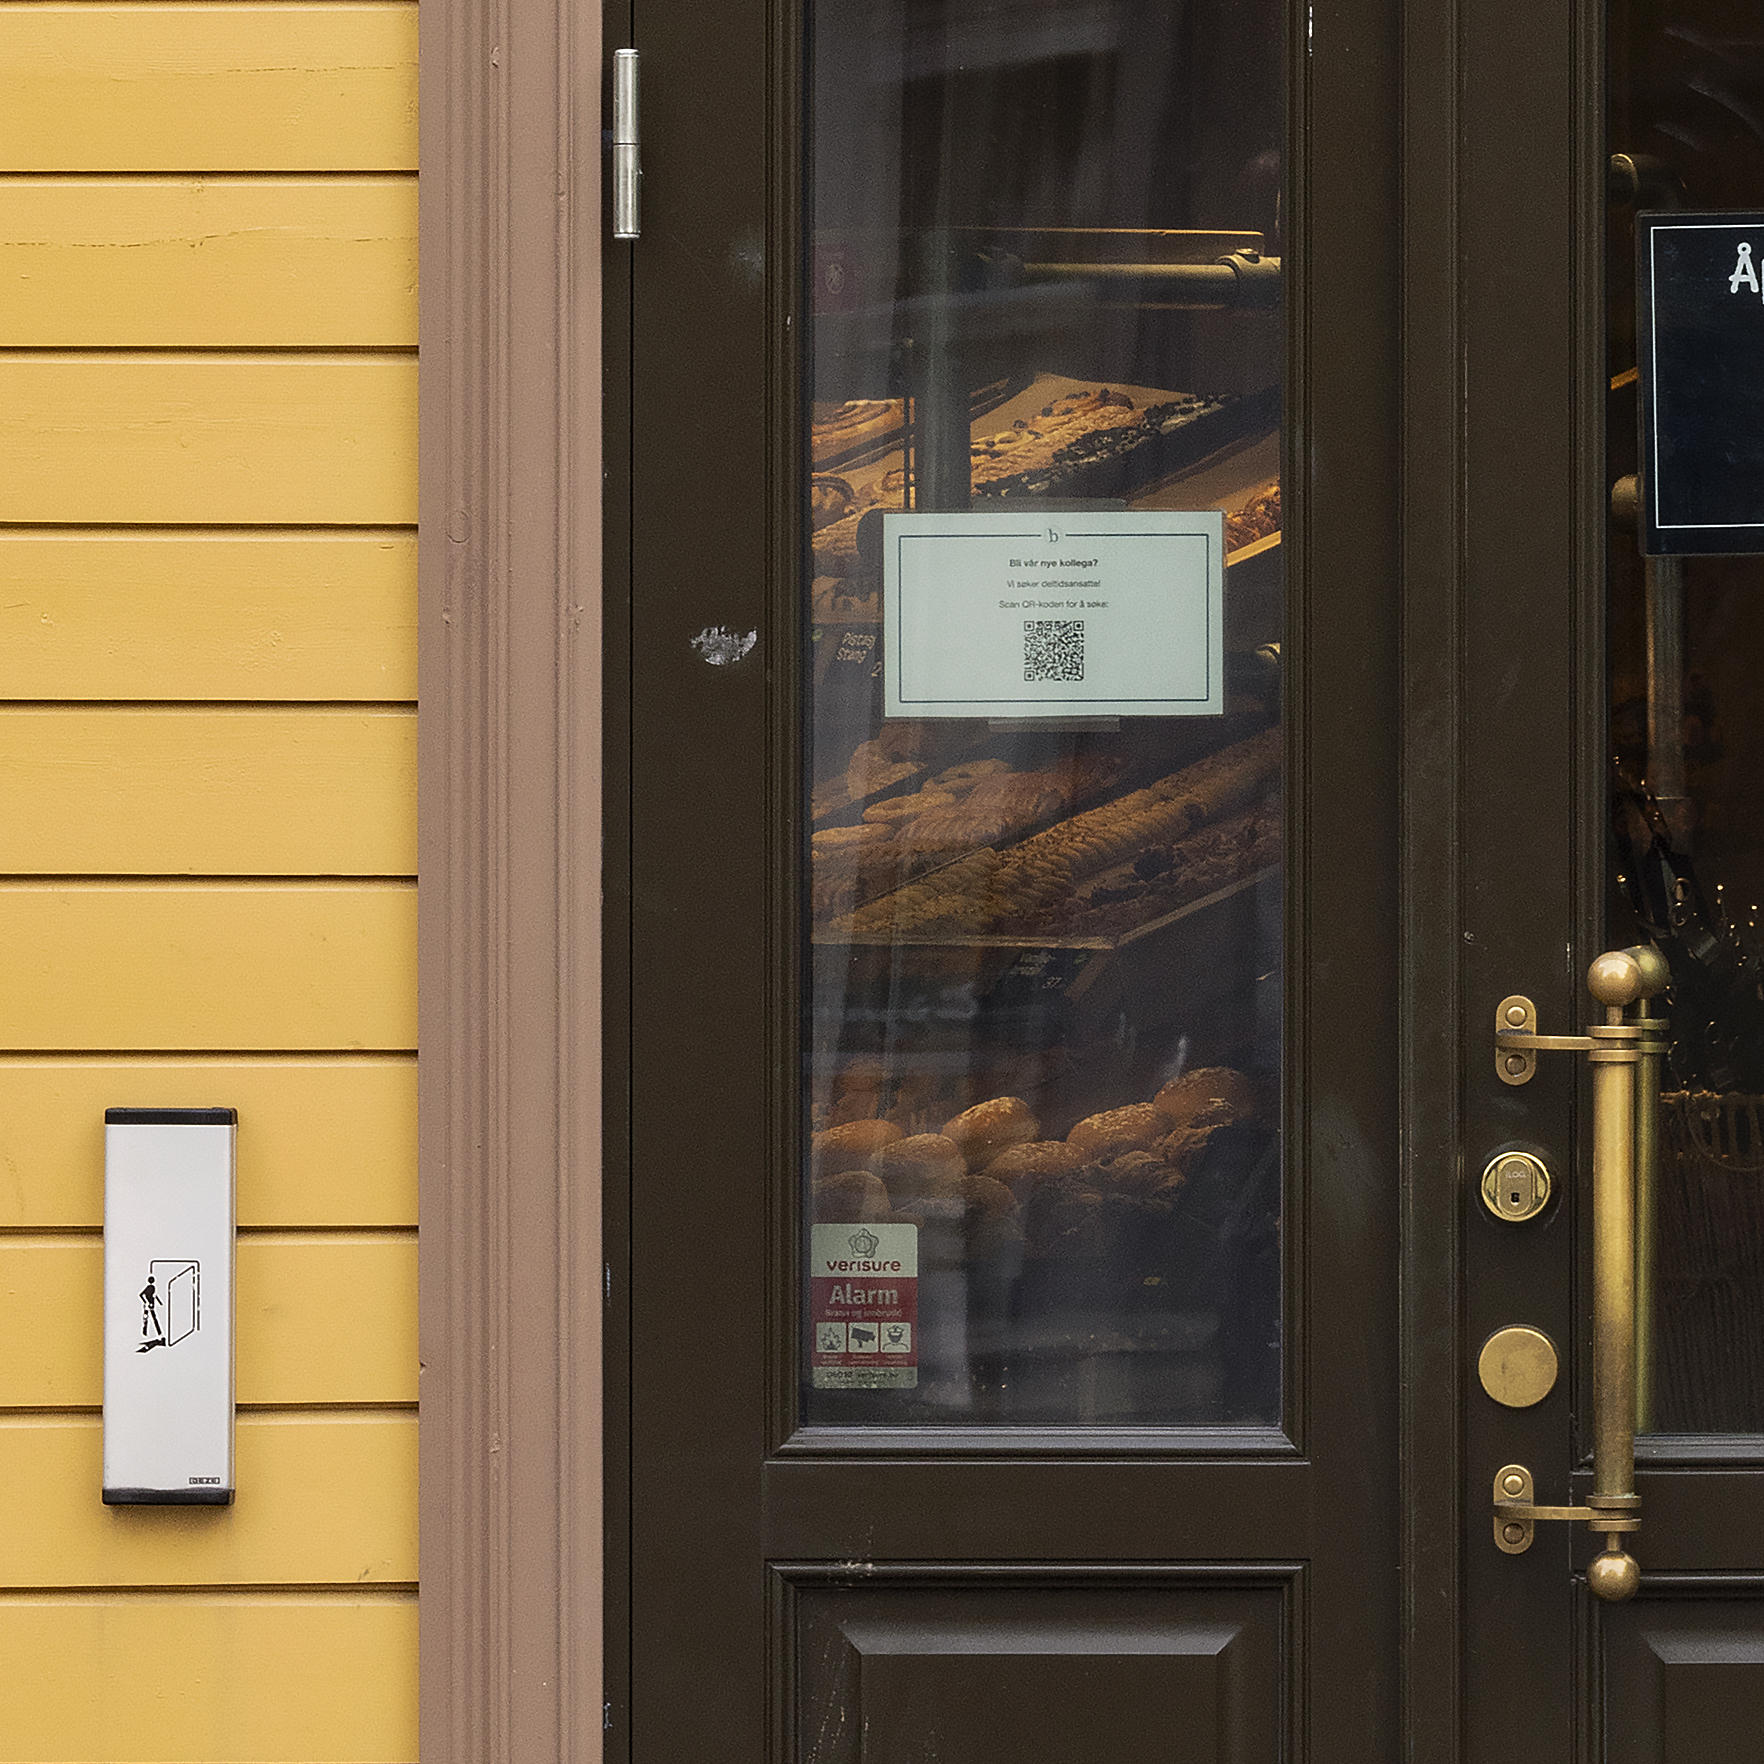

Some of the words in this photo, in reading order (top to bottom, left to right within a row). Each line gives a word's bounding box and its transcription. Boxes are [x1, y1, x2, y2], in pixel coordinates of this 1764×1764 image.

[1009, 559, 1021, 567] Bli
[1023, 559, 1039, 567] vår
[1040, 560, 1058, 569] nye
[1059, 558, 1099, 568] kollega?
[1006, 580, 1015, 588] Vi
[1017, 580, 1039, 588] søker
[999, 600, 1020, 608] Scan
[1022, 600, 1064, 608] QR-koden
[1065, 599, 1078, 608] for
[1079, 599, 1086, 608] å
[826, 1260, 901, 1272] verisure
[829, 1283, 898, 1305] Alarm
